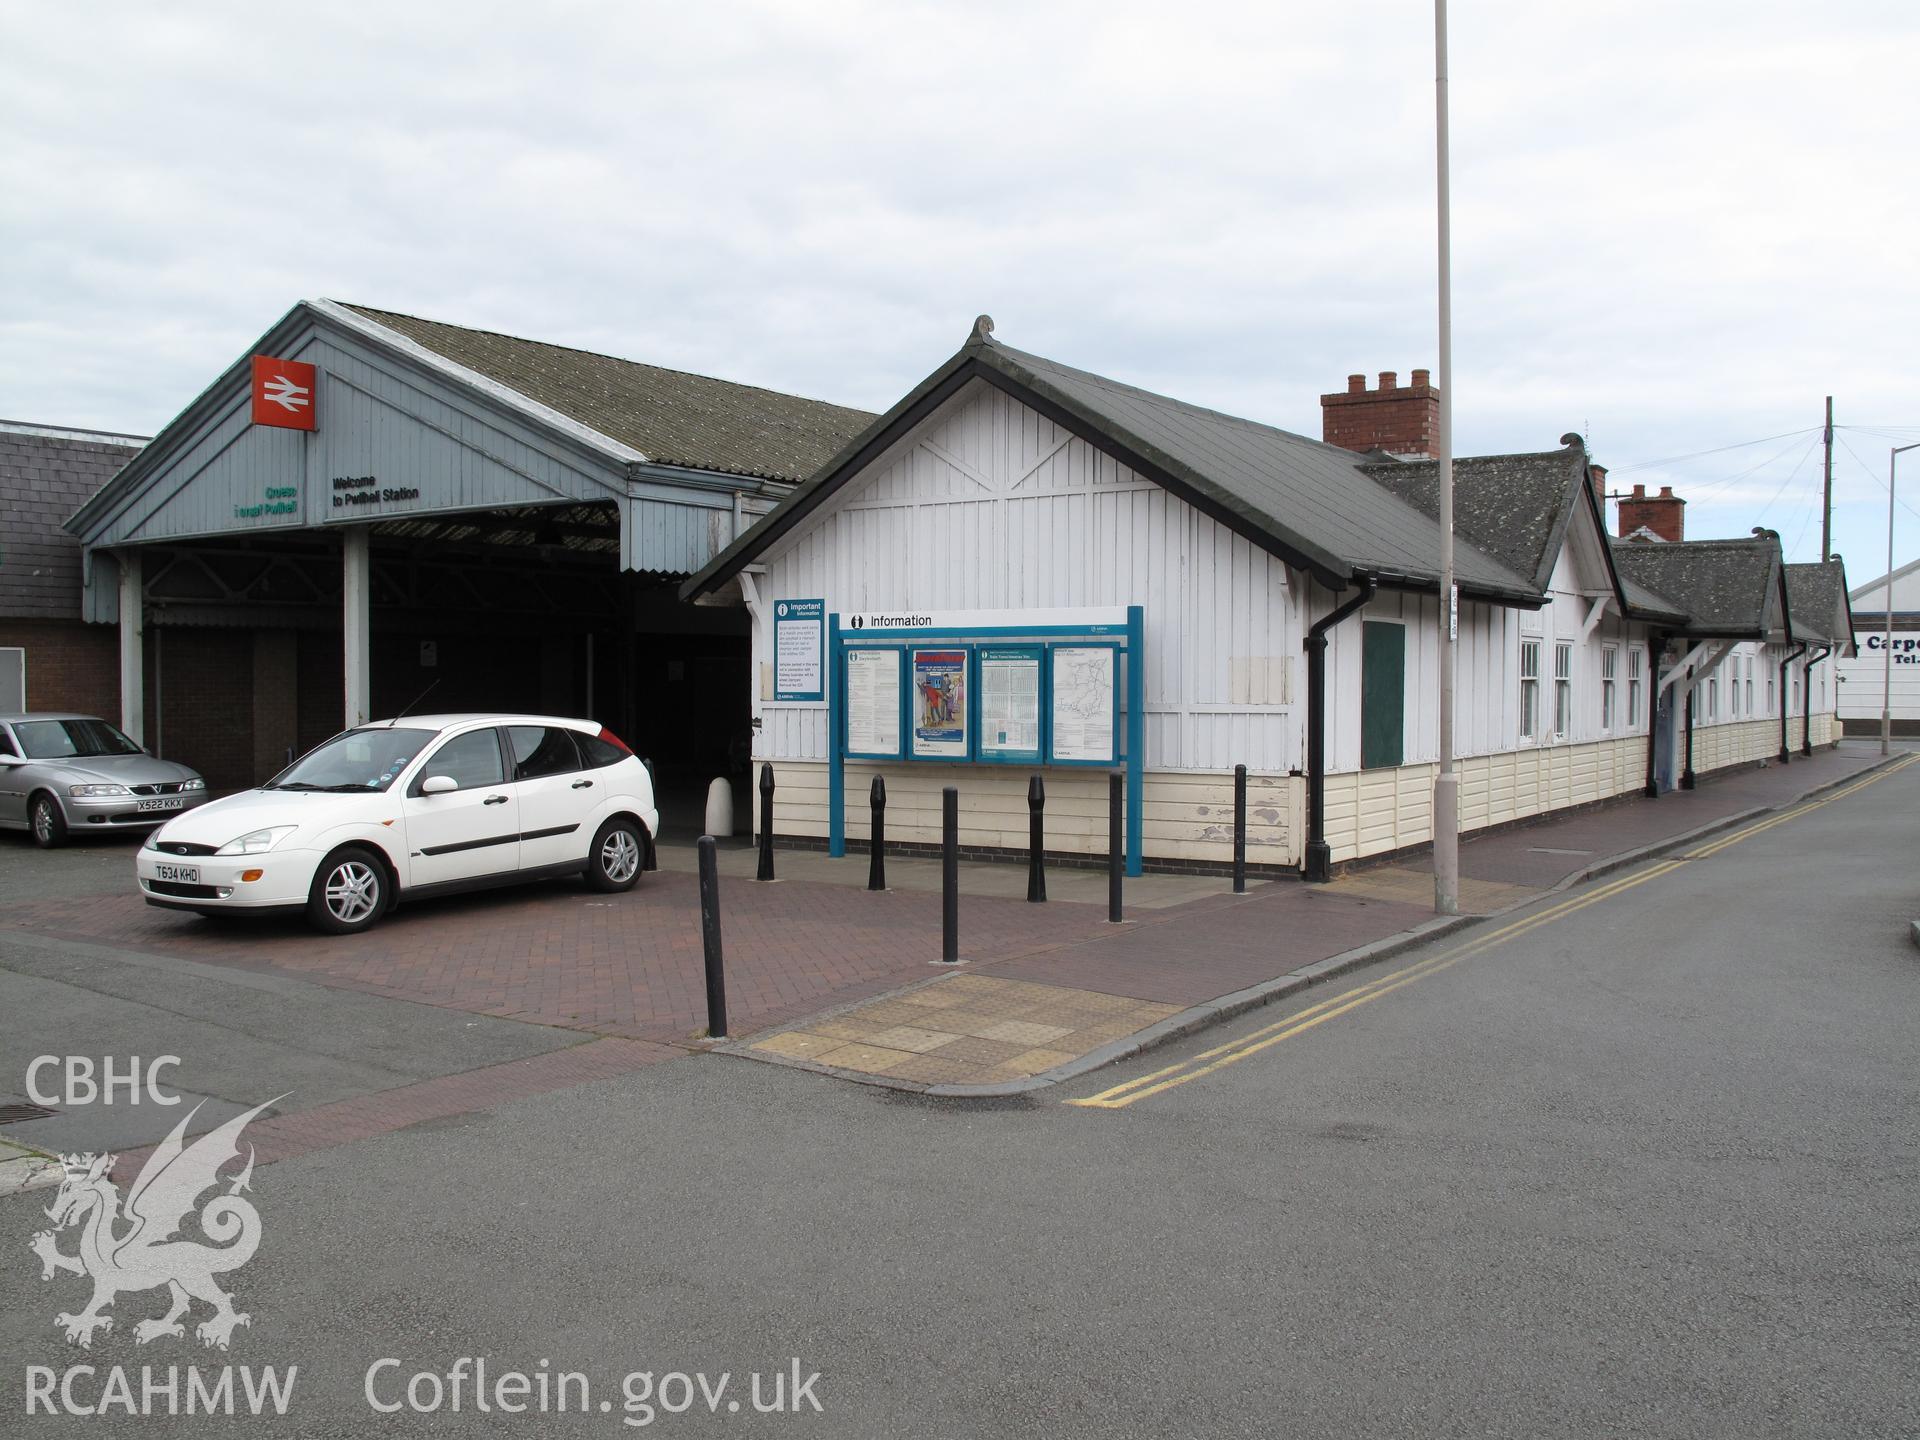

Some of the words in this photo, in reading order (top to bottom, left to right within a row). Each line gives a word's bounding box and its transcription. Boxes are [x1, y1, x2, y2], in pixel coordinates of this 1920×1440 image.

[332, 476, 376, 489] Welcome
[332, 494, 343, 507] to
[345, 490, 380, 505] Pwllheli
[382, 487, 419, 502] Station
[790, 603, 821, 611] Important
[870, 615, 932, 627] Information
[139, 800, 163, 810] X522
[164, 799, 182, 809] KKX
[156, 865, 178, 880] T634
[180, 868, 198, 882] KHD
